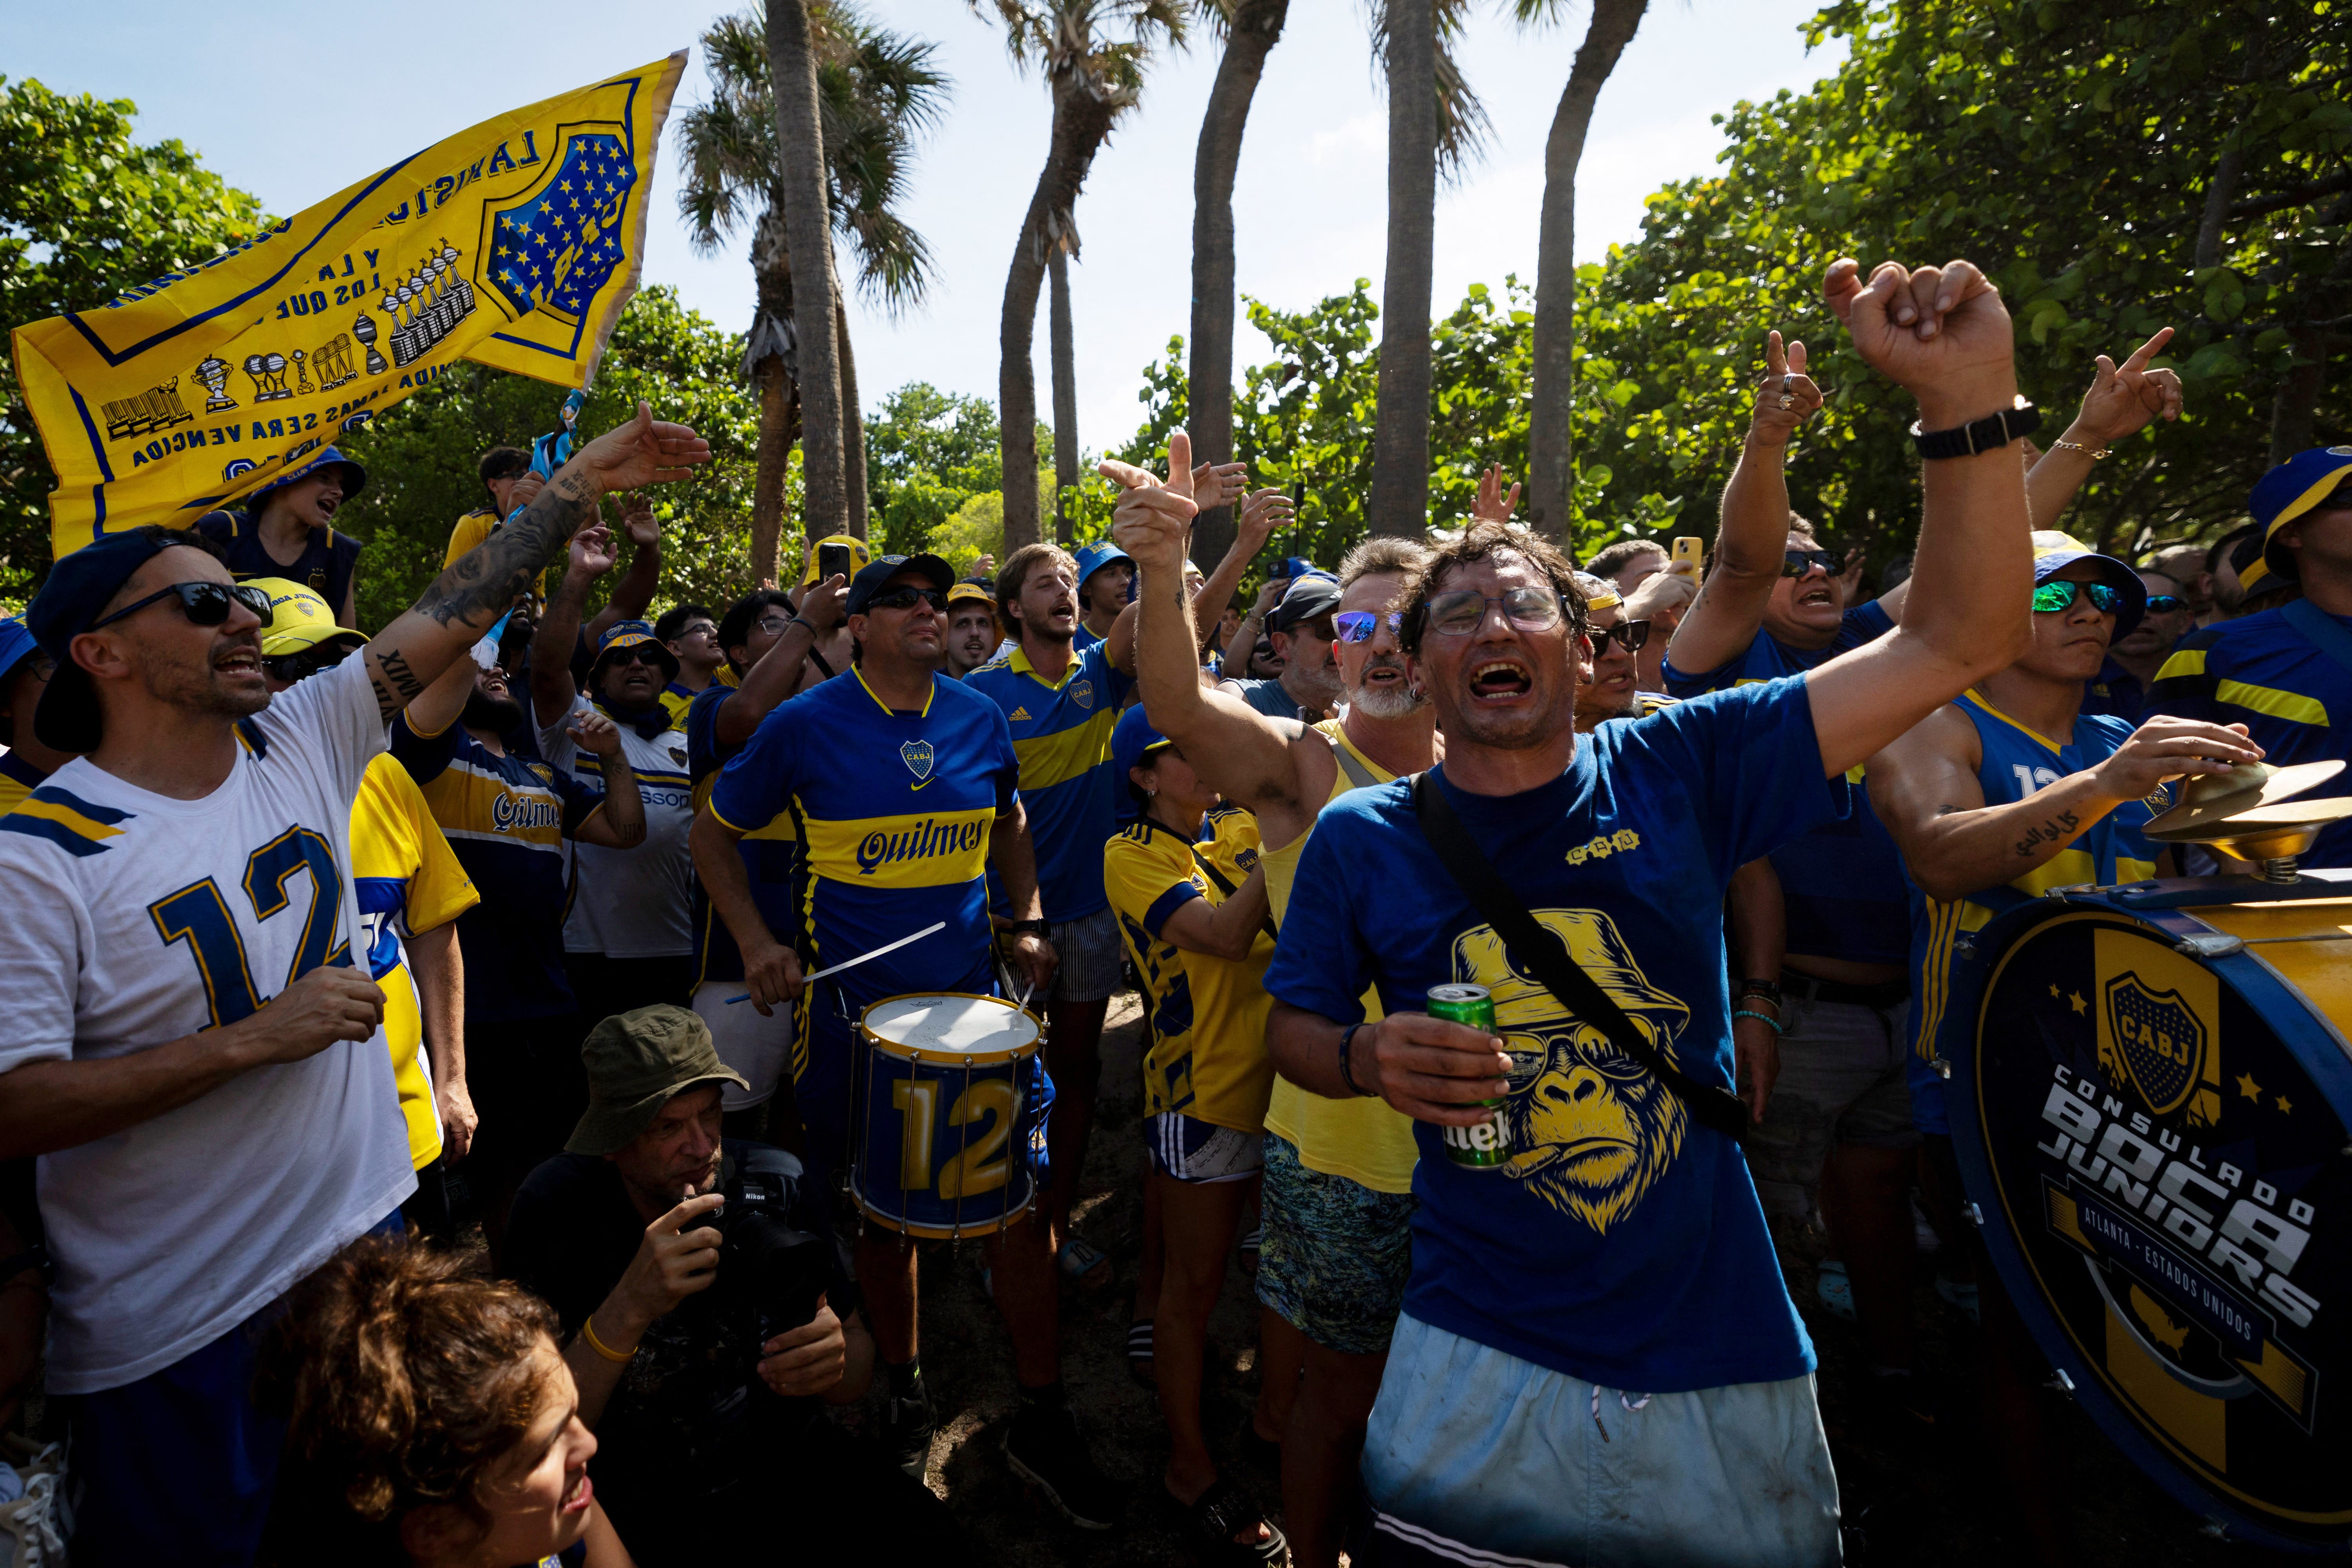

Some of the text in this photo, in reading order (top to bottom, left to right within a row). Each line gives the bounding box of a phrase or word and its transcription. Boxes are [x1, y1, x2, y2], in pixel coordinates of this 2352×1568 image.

[1073, 688, 1091, 698] CABJ
[906, 752, 931, 760] CABJ
[856, 818, 985, 876] Quilmes
[147, 822, 355, 1032] 12
[2122, 1014, 2189, 1067] CABJ
[892, 1078, 1019, 1200] 12
[2041, 1082, 2311, 1276] BOCA
[2054, 1064, 2315, 1225] CONSULADO
[1069, 1243, 1094, 1266] 10
[2037, 1132, 2321, 1328] JUNIORS
[2084, 1207, 2130, 1250] ATLANTA
[2145, 1244, 2198, 1297] ESTADOS
[2203, 1287, 2252, 1341] UNIDOS
